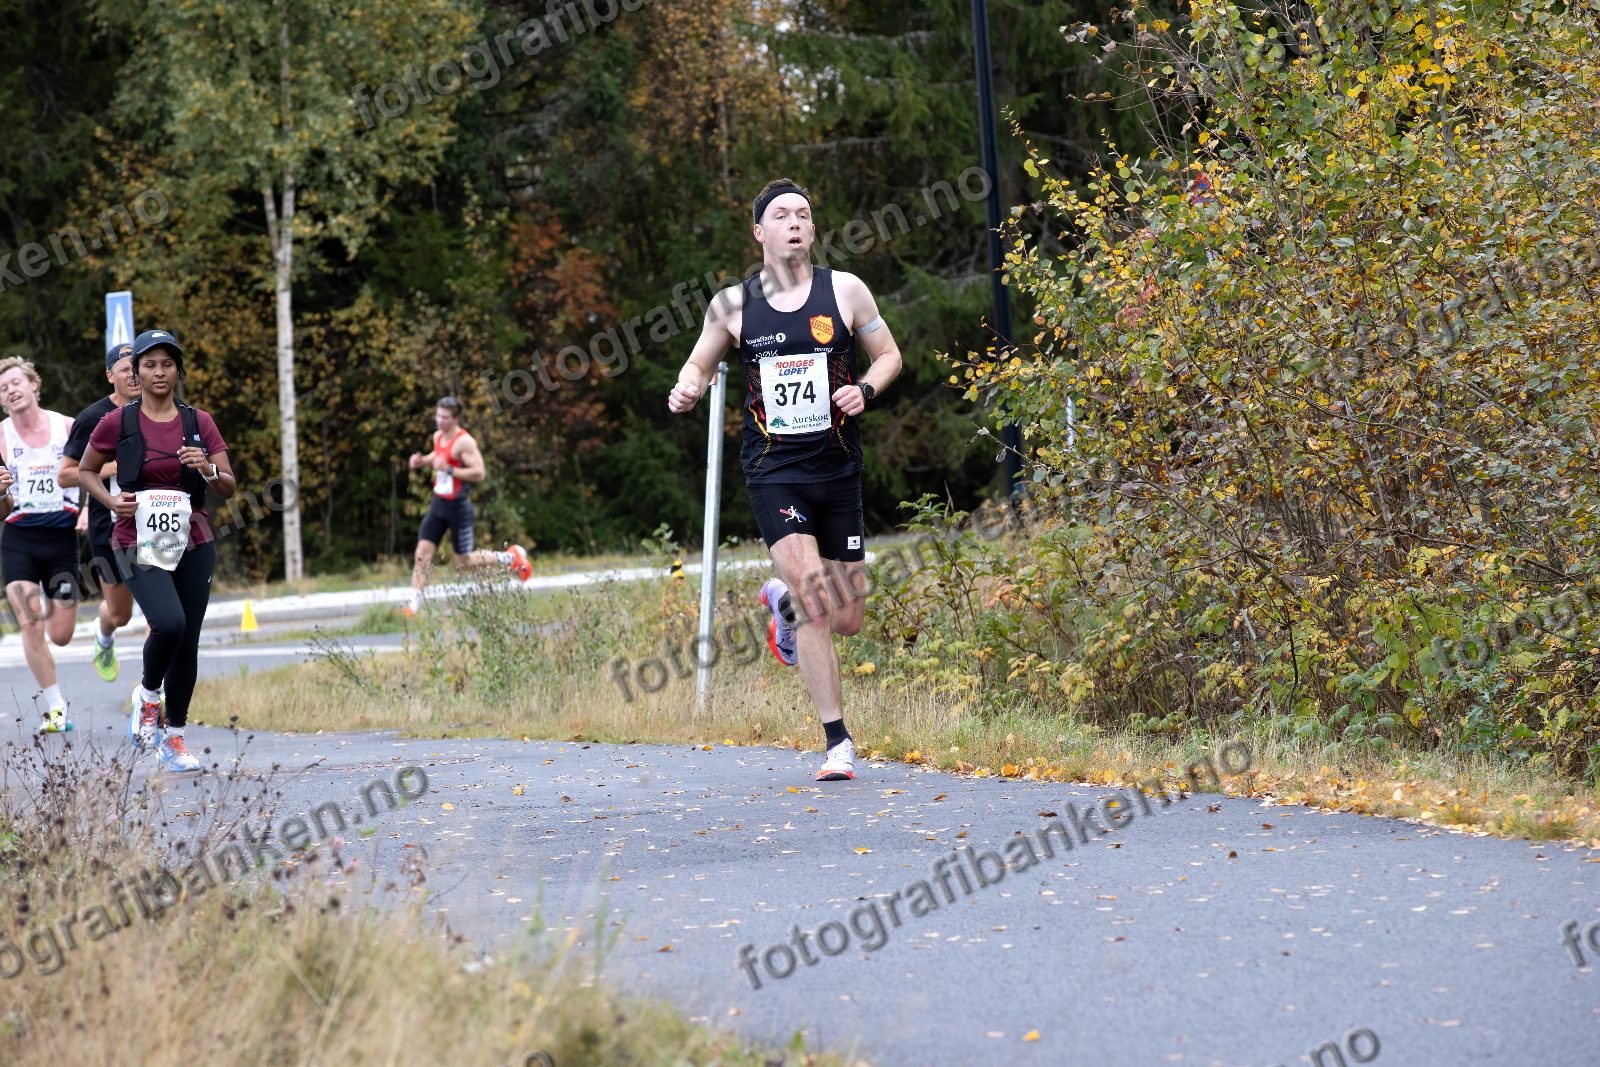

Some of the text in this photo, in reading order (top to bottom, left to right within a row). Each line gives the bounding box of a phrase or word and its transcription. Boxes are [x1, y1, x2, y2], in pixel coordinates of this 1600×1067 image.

[775, 358, 815, 369] NORGES
[779, 367, 808, 377] LØPET
[774, 380, 817, 407] 374
[791, 413, 830, 425] Aurskog
[27, 478, 54, 495] 743
[148, 494, 183, 502] NORGES
[146, 512, 182, 533] 485
